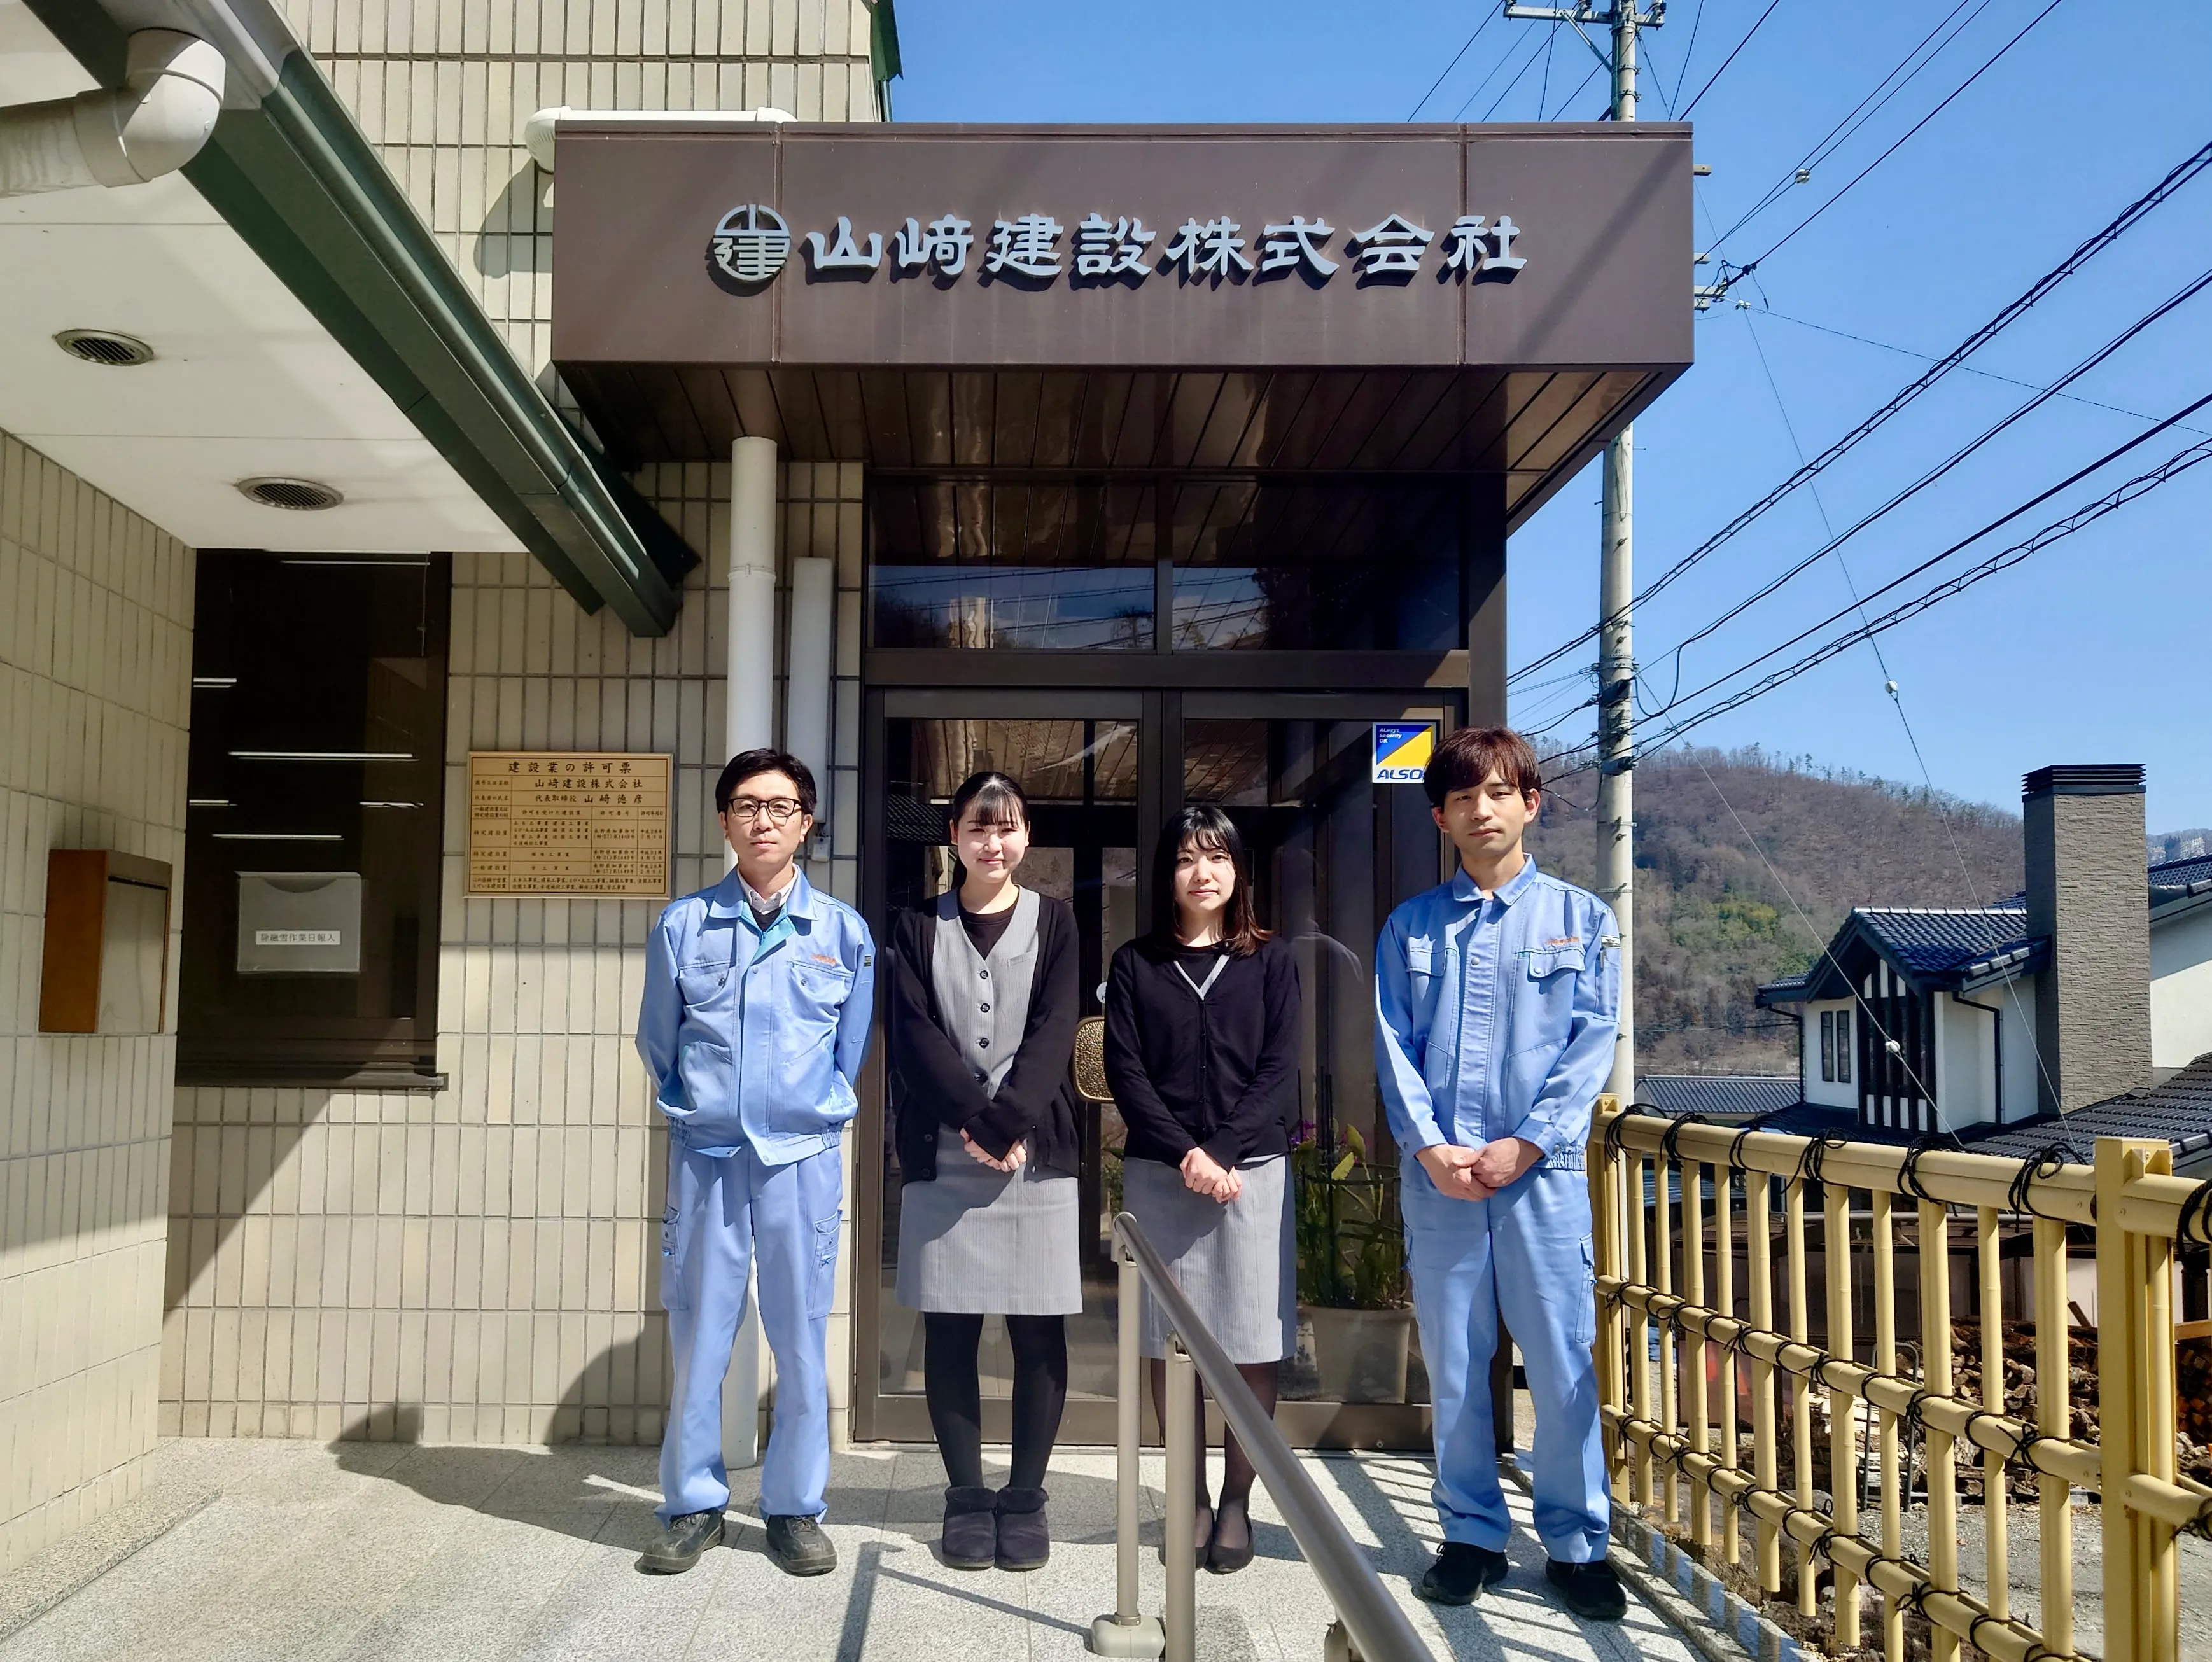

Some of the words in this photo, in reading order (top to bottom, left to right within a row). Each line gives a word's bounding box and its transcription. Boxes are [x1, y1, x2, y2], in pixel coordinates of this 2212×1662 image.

[508, 761, 632, 774] 建設業の許可票
[1377, 769, 1424, 779] ALSO
